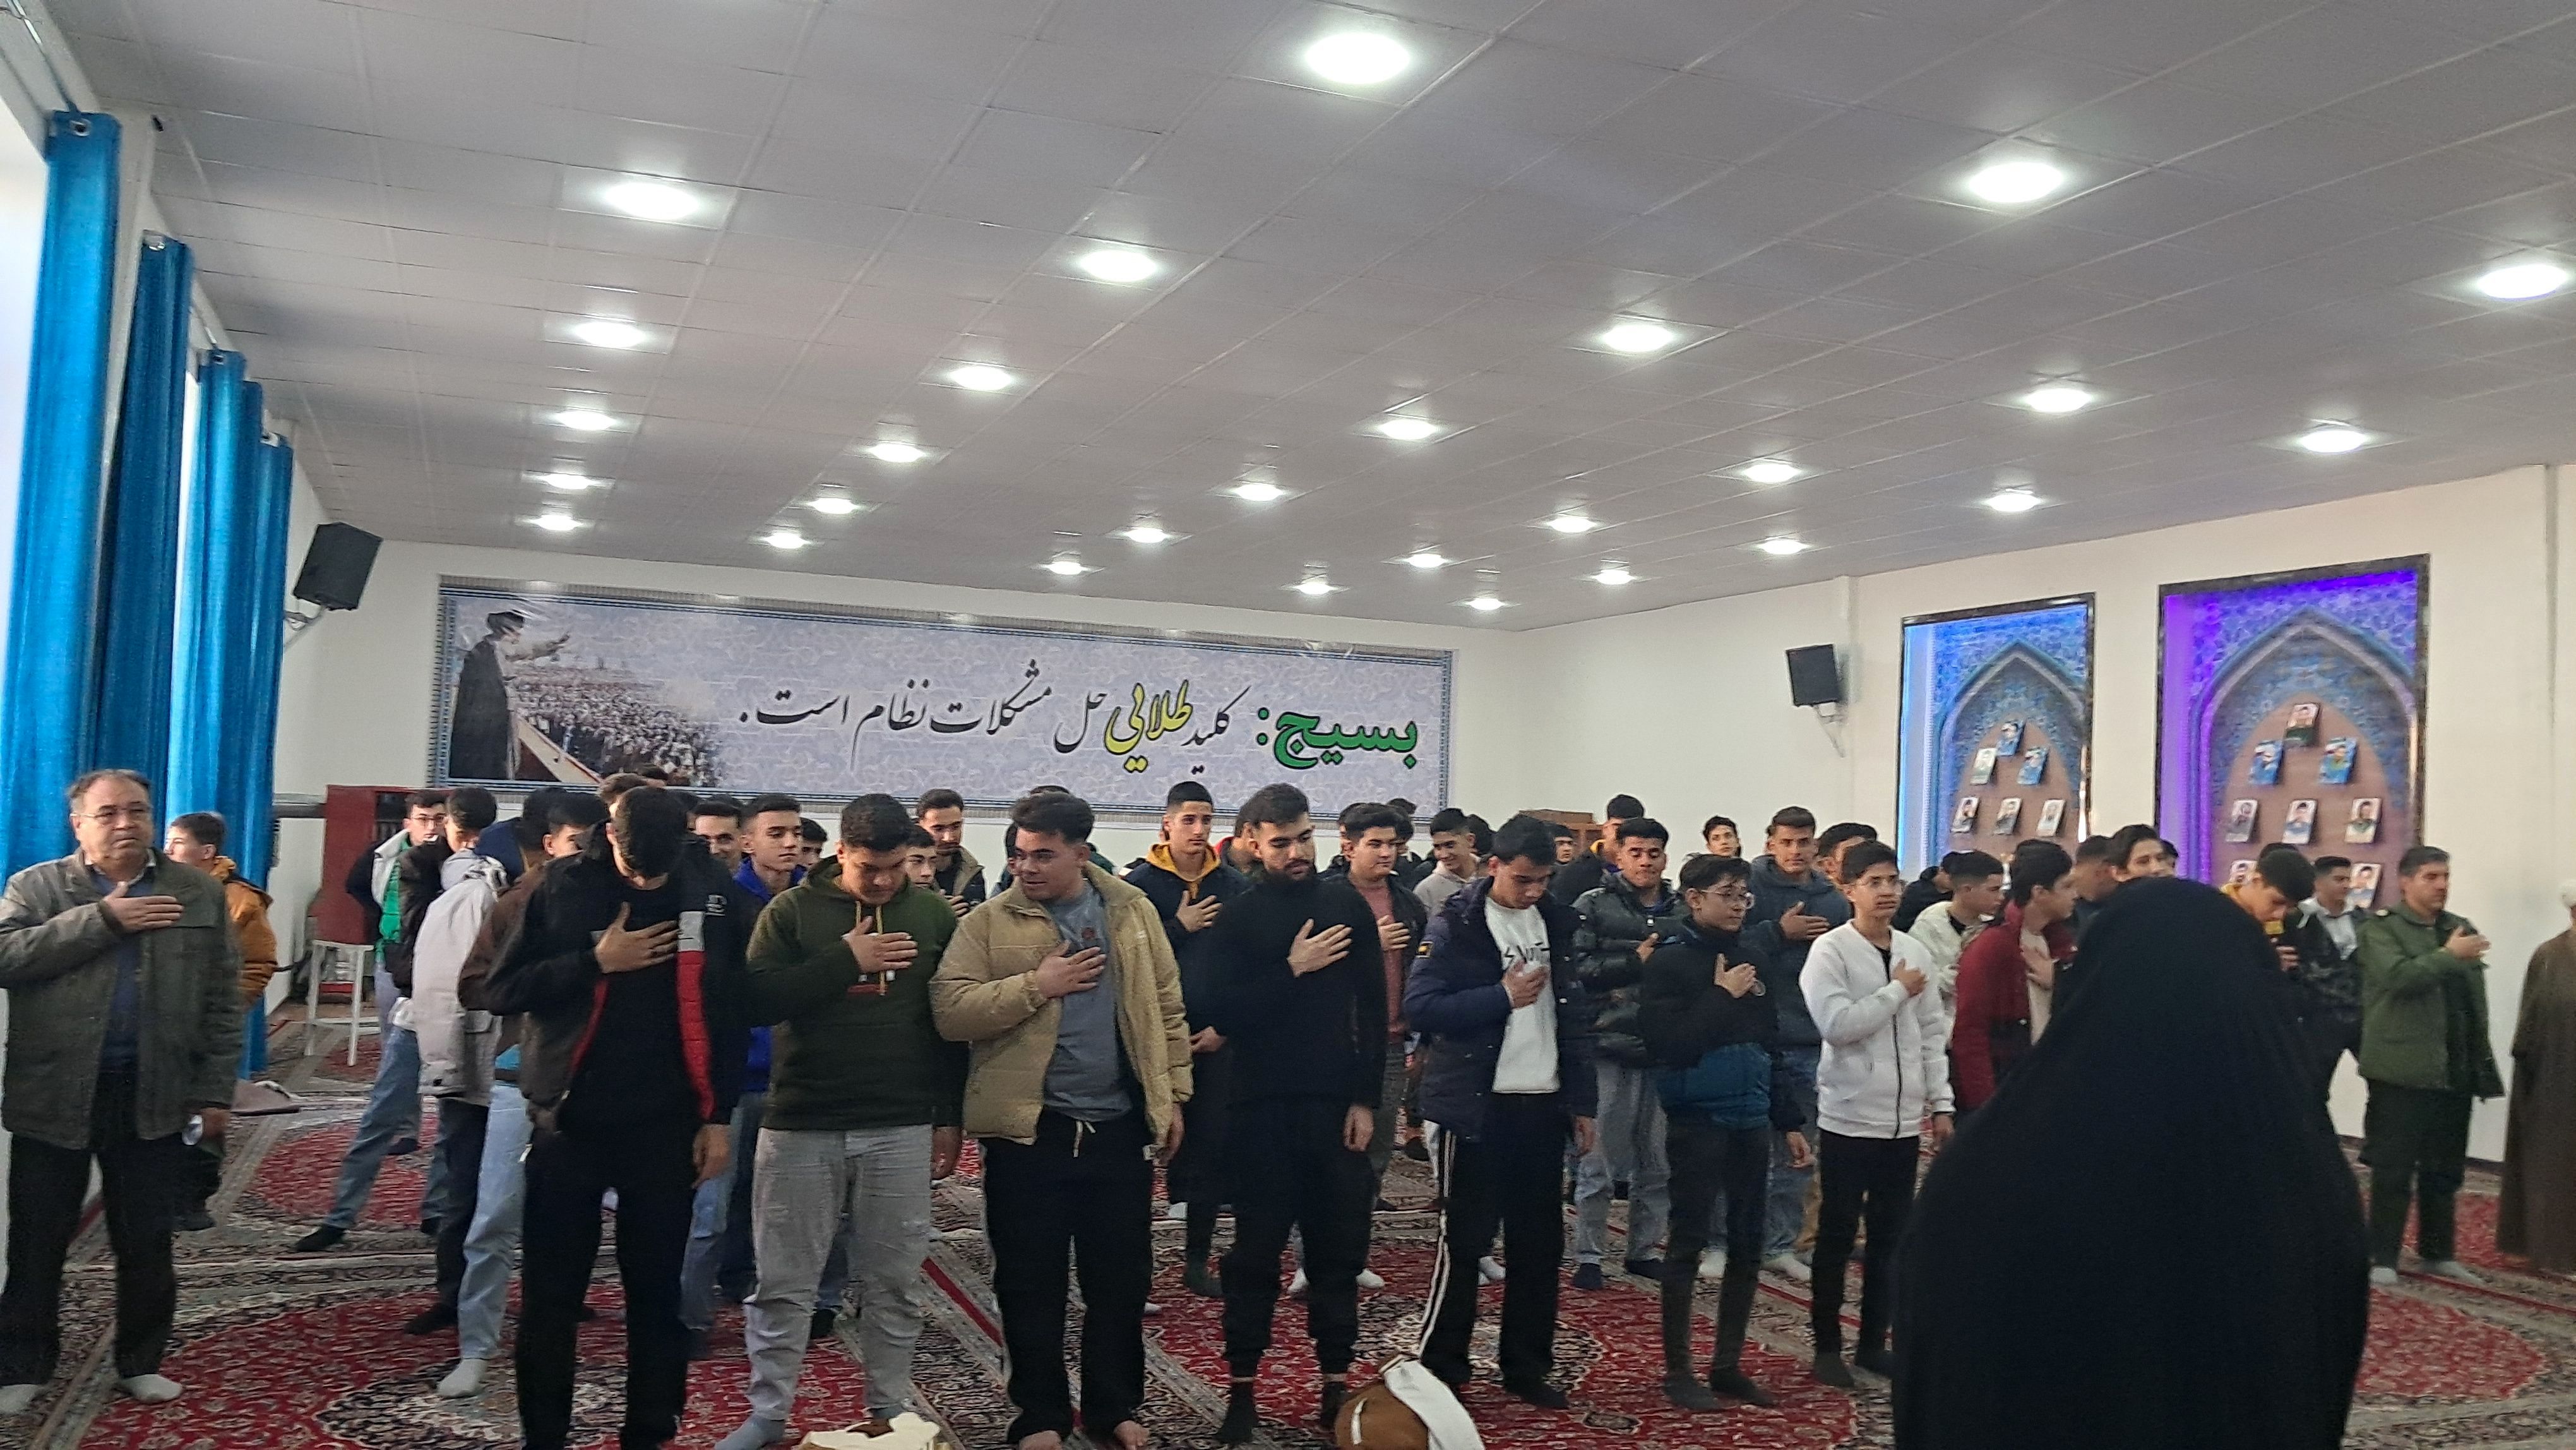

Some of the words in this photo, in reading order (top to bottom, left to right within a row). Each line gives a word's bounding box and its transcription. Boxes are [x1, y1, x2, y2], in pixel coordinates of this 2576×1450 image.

[739, 689, 850, 726] است.
[850, 678, 929, 770] نظام
[929, 659, 1052, 735] مشکلات
[1054, 691, 1107, 753] حل
[1104, 679, 1193, 773] طلایی
[1181, 685, 1251, 775] کلید
[1257, 707, 1418, 770] بسیج:
